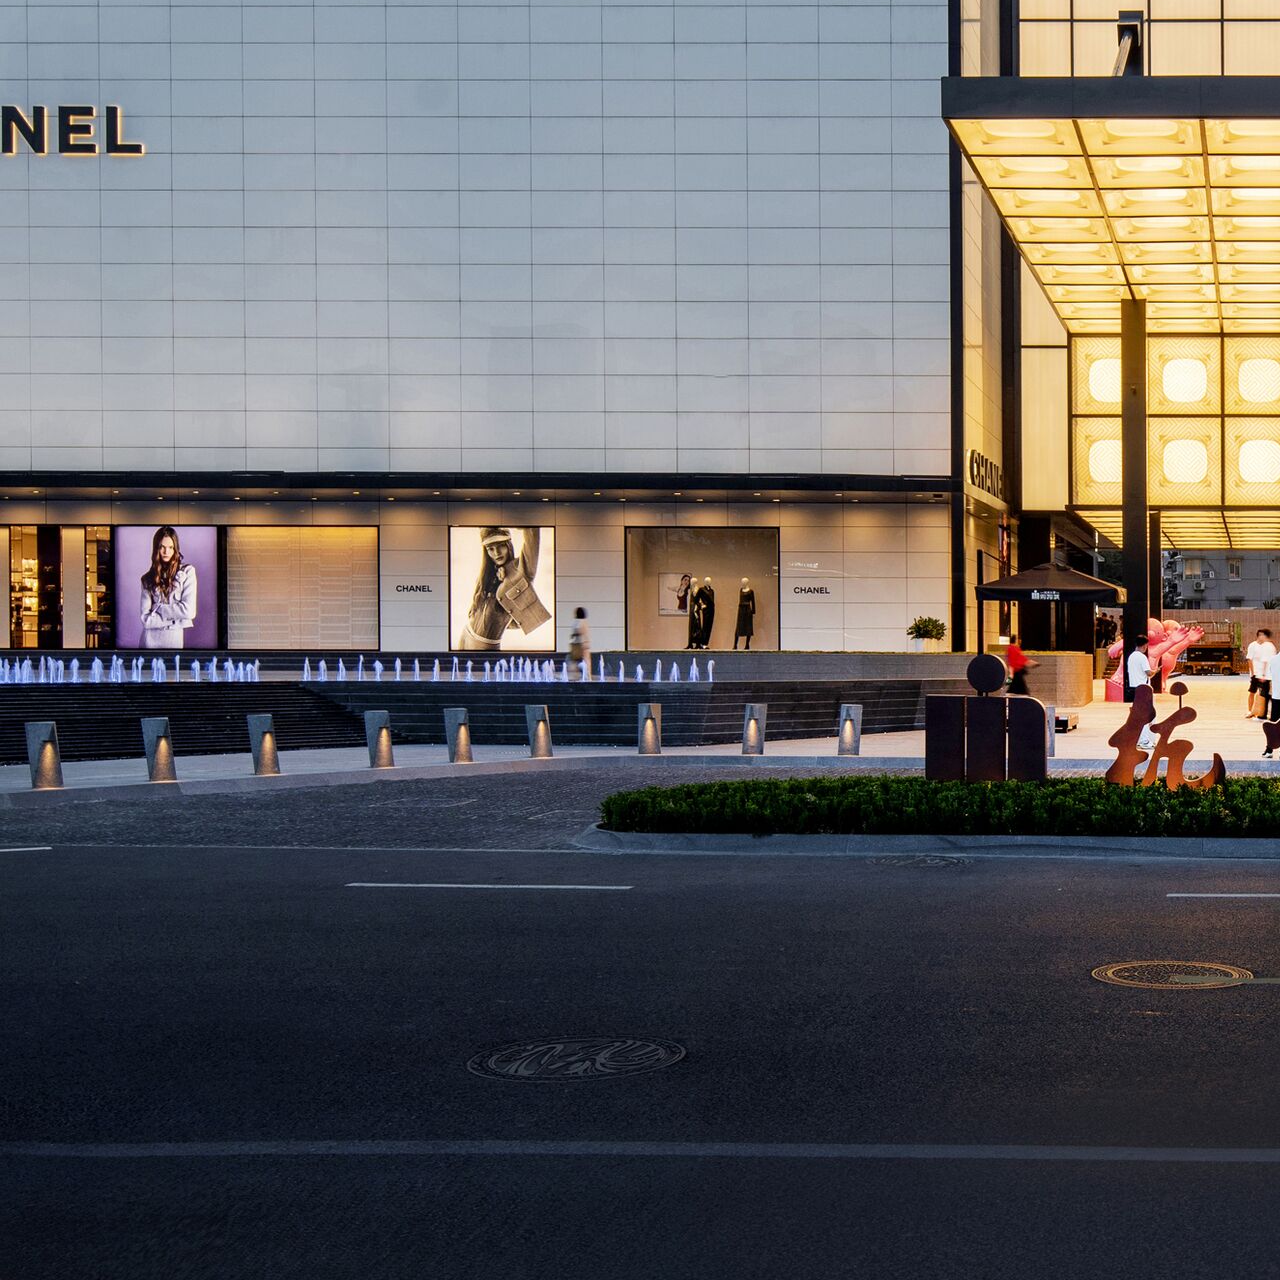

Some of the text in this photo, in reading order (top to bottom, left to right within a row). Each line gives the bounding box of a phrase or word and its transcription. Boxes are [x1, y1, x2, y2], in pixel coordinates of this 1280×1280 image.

[1, 105, 145, 156] NEL
[967, 449, 1004, 500] CHANE
[395, 584, 433, 593] CHANEL
[793, 586, 831, 594] CHANEL
